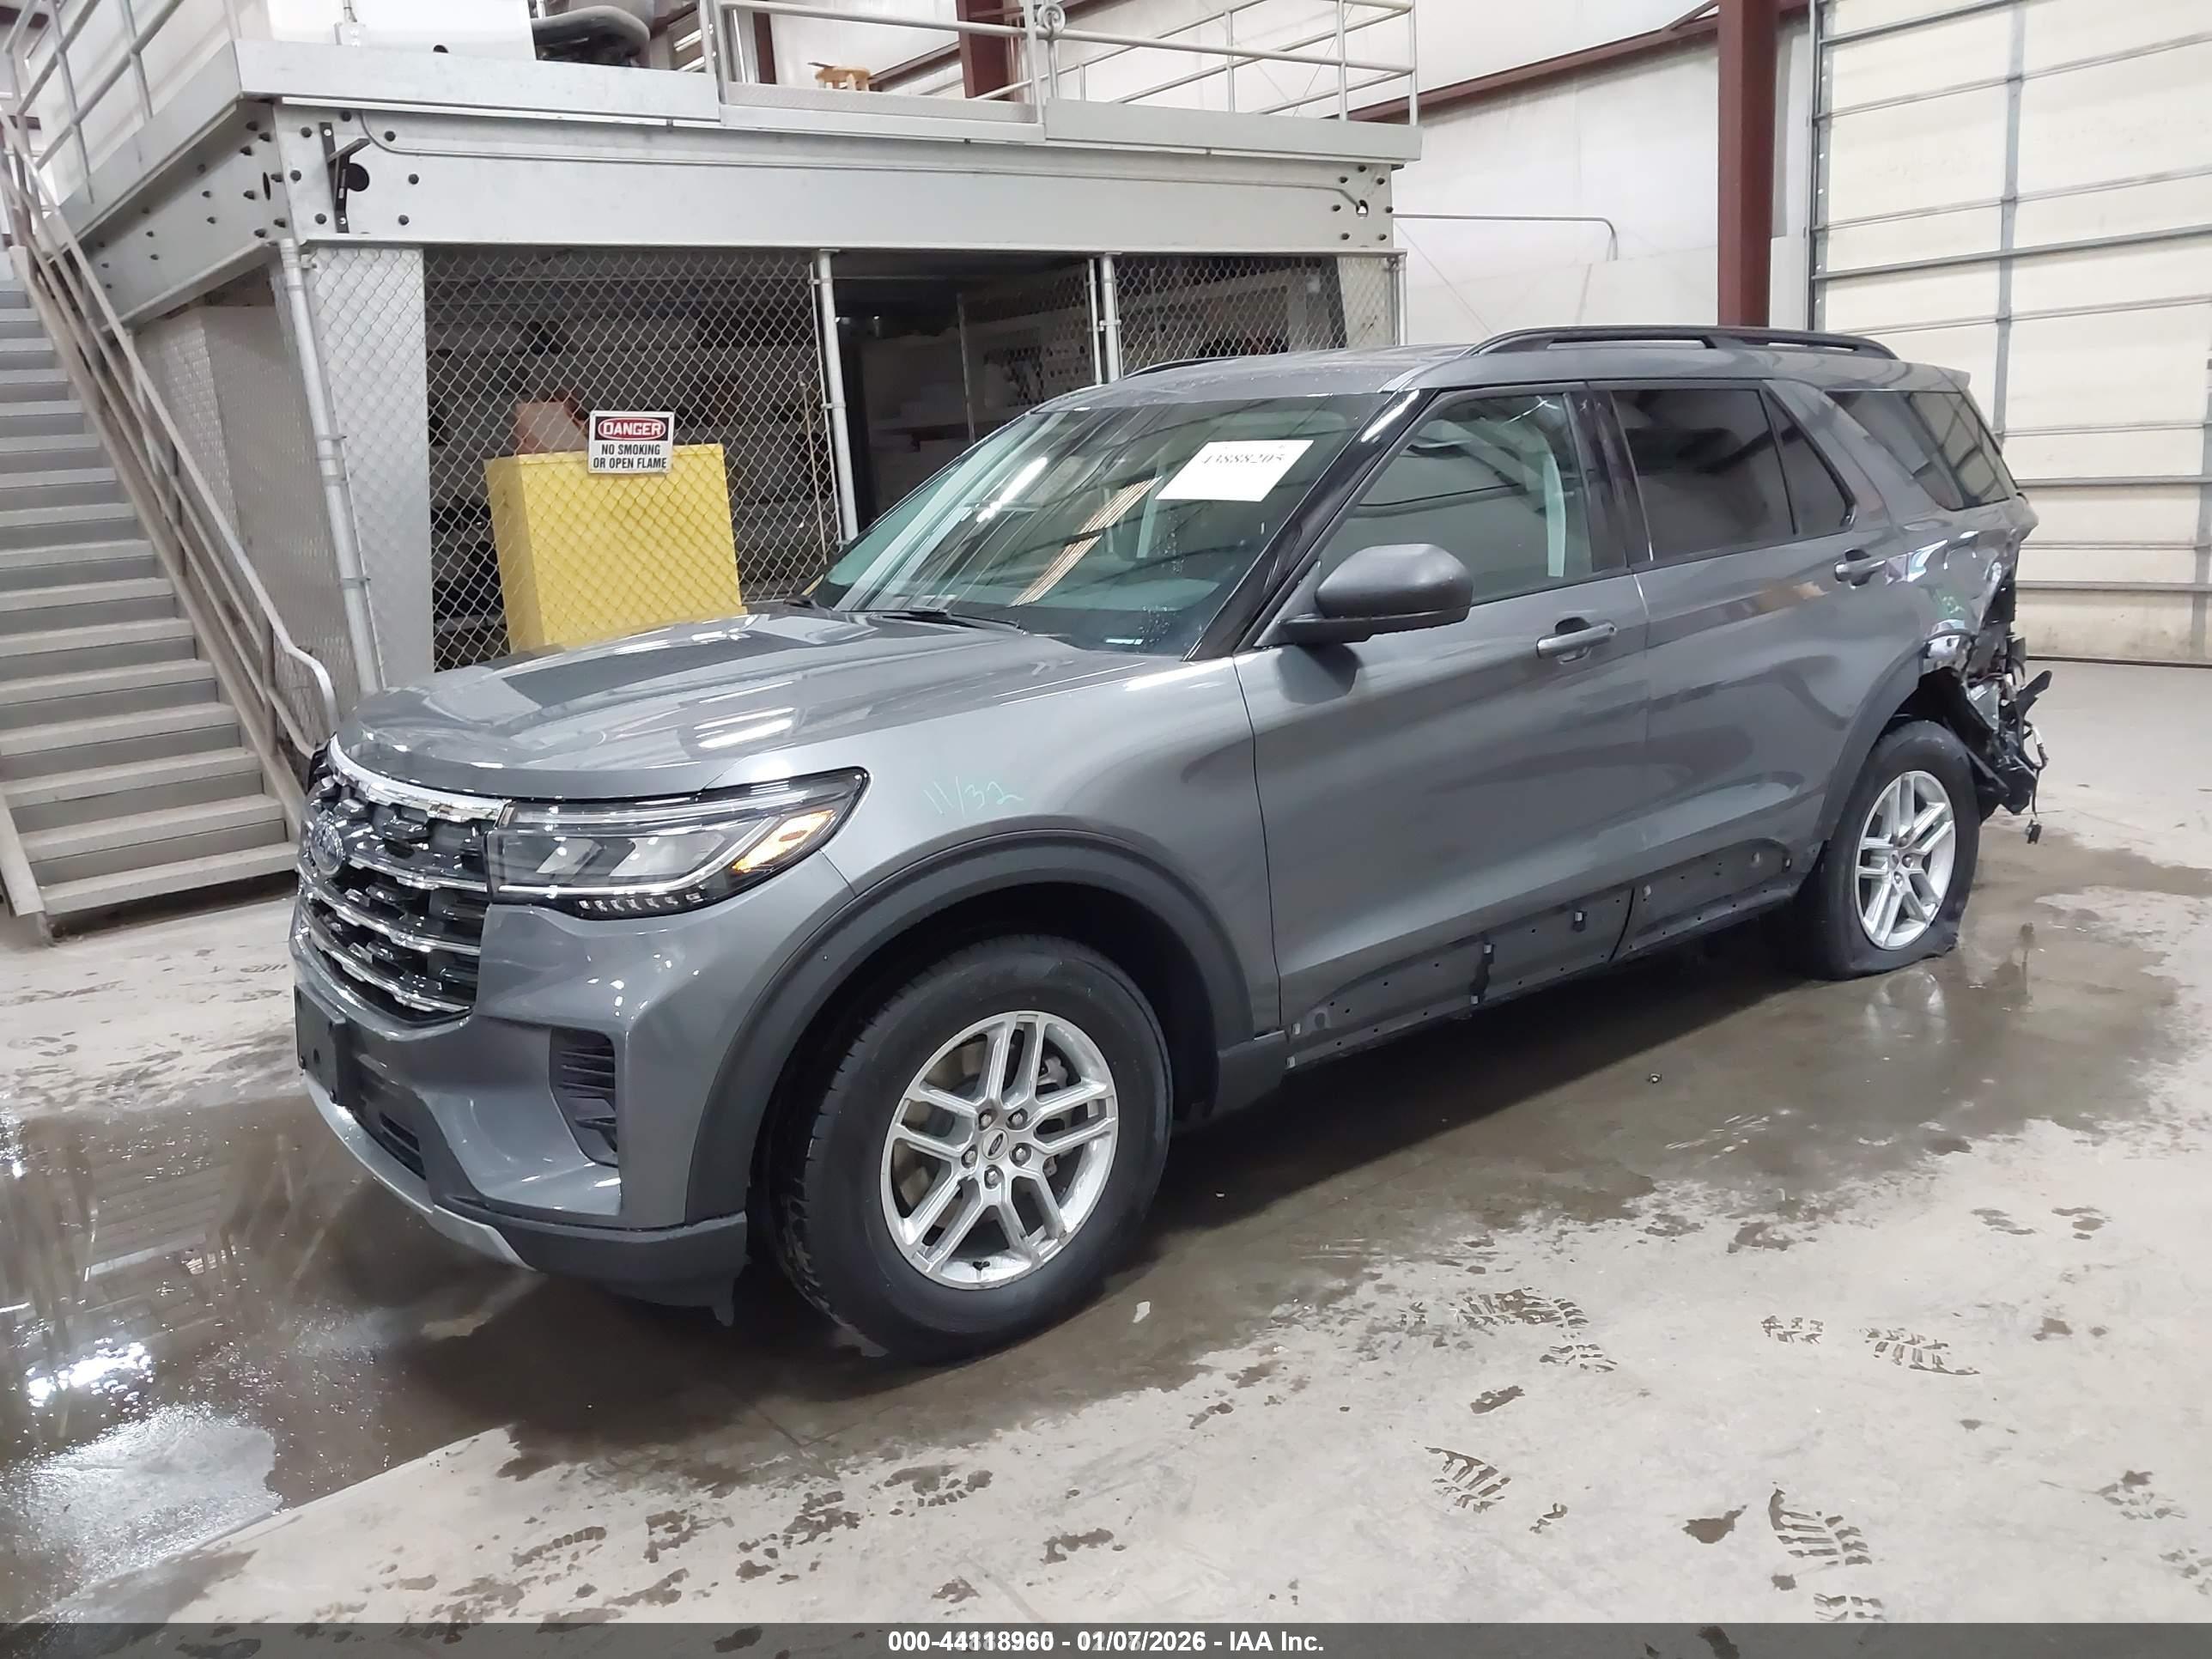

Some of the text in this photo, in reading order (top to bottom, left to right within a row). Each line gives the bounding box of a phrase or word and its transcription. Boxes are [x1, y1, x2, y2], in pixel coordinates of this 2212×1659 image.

[603, 422, 661, 435] DANGER
[601, 444, 660, 455] NO SMOKING
[592, 457, 667, 469] OR OPEN FLAME
